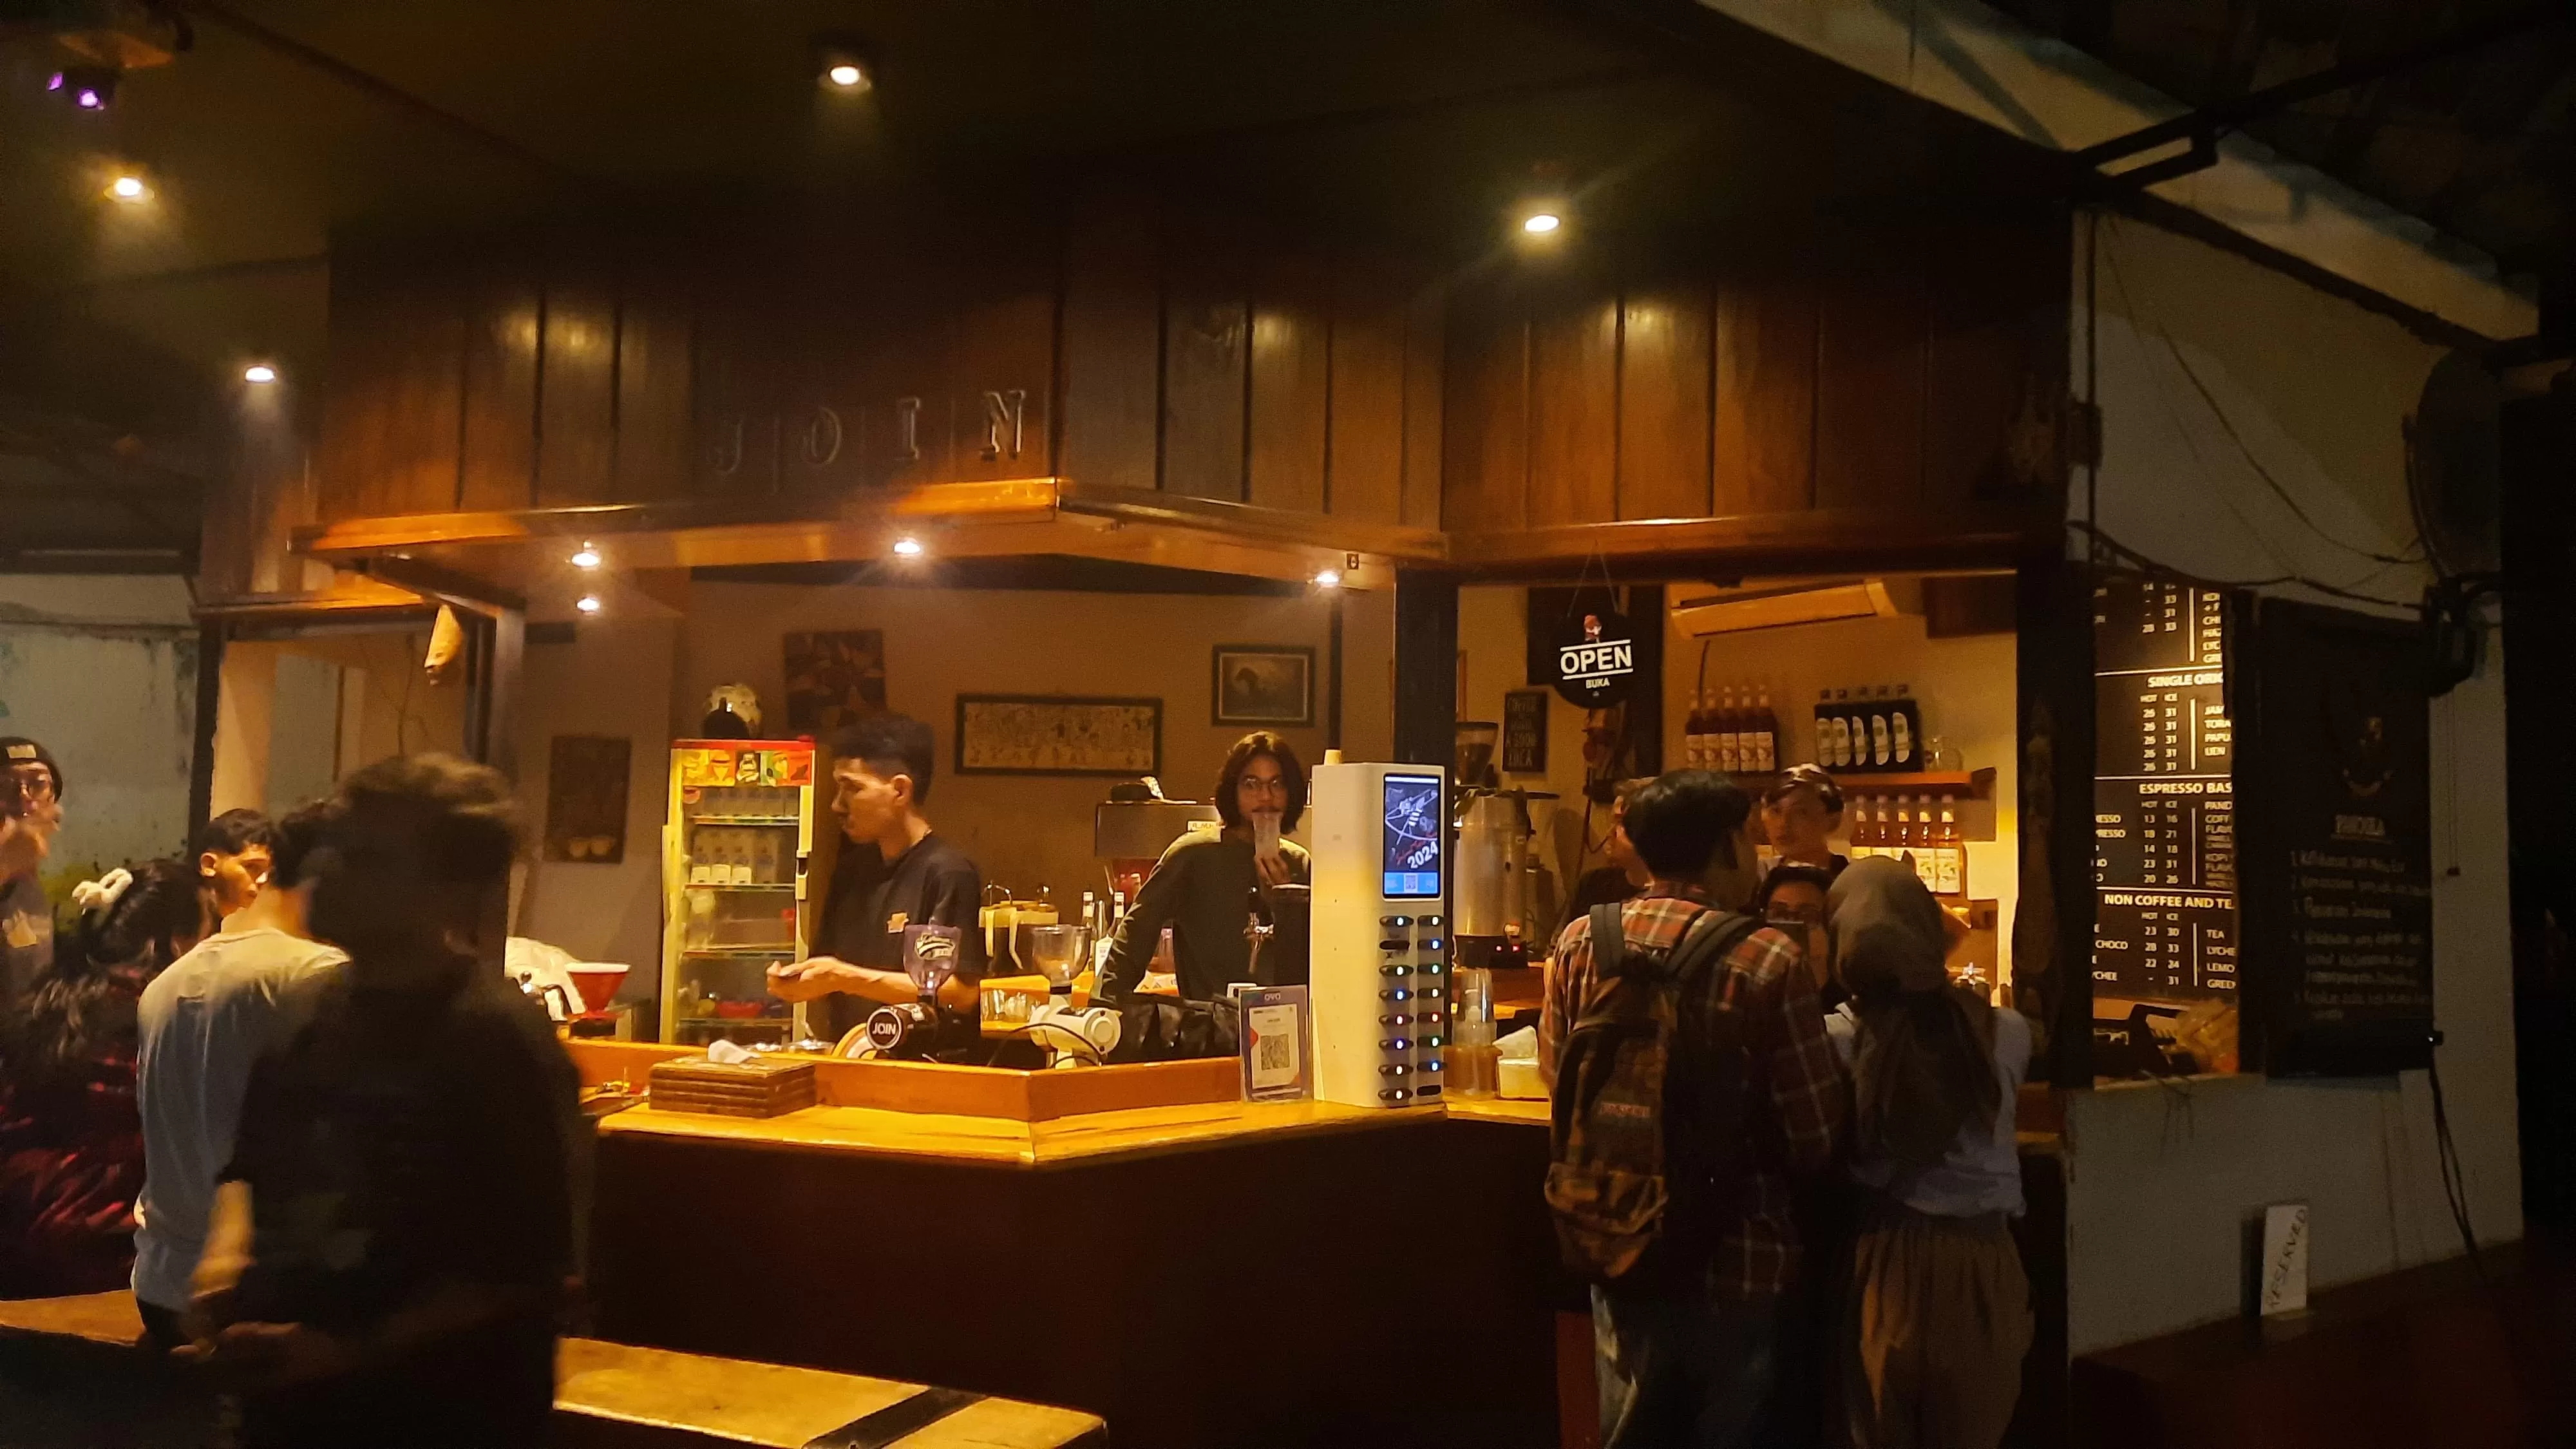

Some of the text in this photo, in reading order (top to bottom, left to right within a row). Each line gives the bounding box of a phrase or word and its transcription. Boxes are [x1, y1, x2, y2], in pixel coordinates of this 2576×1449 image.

[706, 389, 1027, 475] JOIN
[1560, 645, 1633, 674] OPEN
[1586, 677, 1610, 689] BUKA
[2148, 674, 2193, 687] SINGLE
[2139, 783, 2203, 793] ESPRESSO
[1407, 841, 1438, 869] 2024
[2144, 860, 2177, 868] 23 31
[2105, 895, 2234, 909] NON COFFEE AND TE
[2207, 929, 2224, 938] TEA
[2169, 976, 2179, 985] 31
[872, 1022, 897, 1036] JOIN
